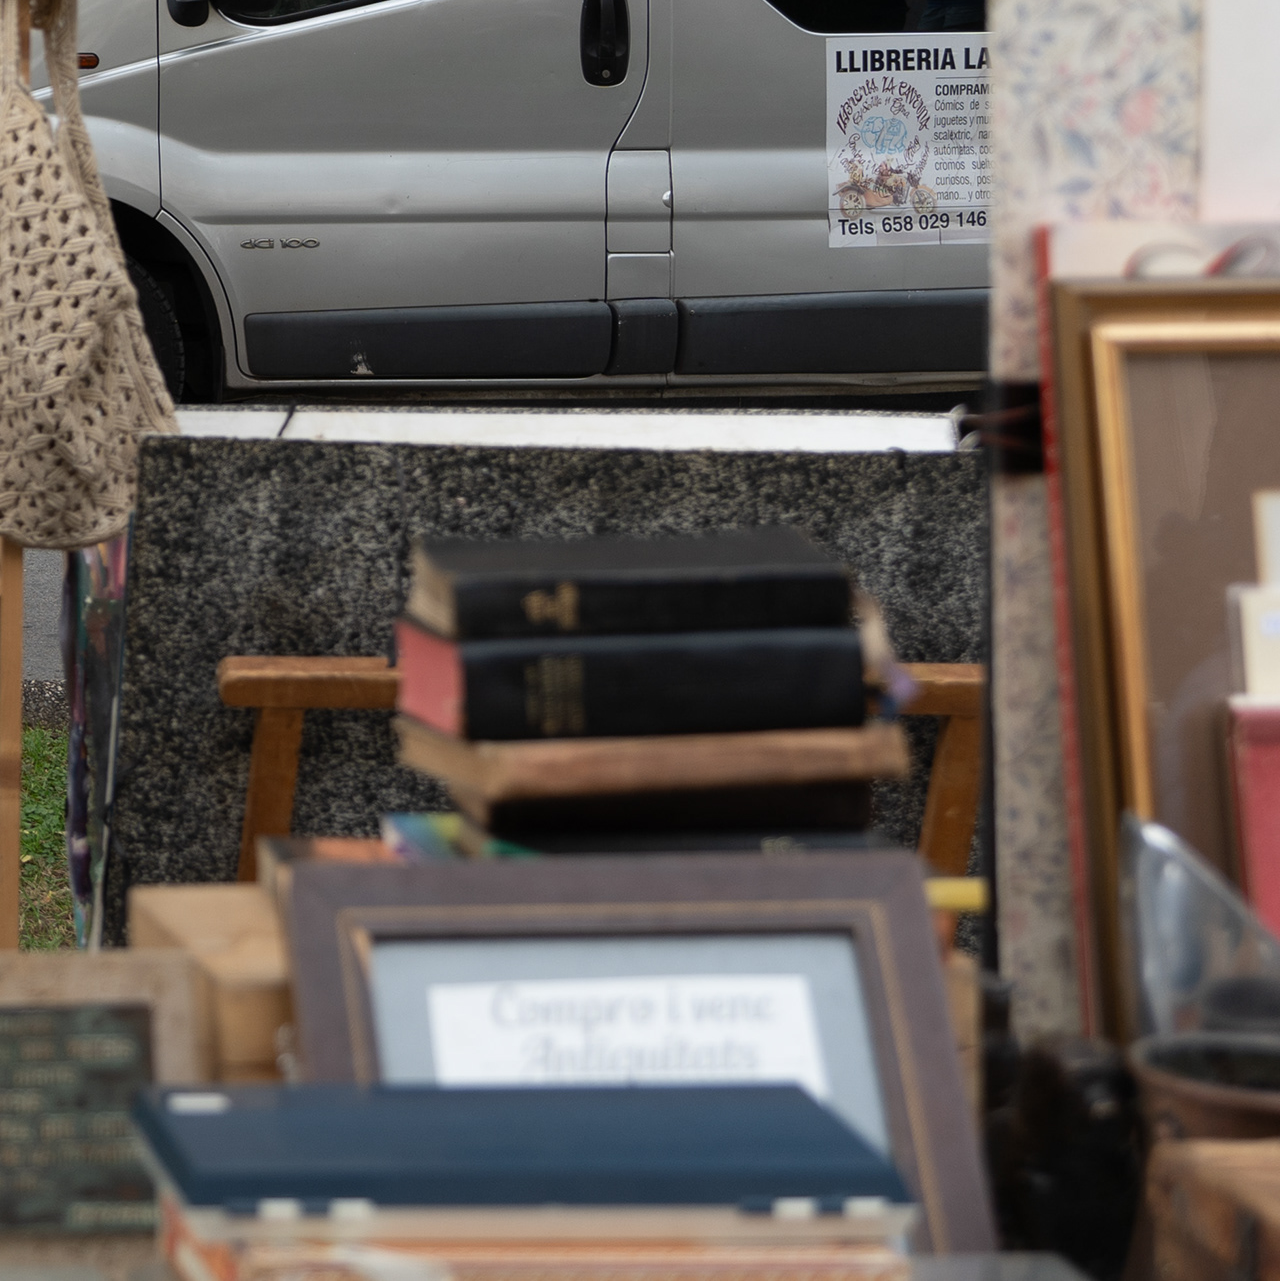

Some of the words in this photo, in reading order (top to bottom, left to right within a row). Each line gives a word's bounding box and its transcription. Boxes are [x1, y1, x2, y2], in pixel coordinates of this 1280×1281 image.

[835, 47, 957, 73] LLIBRERIA
[934, 99, 965, 111] Cómics
[970, 98, 980, 110] de
[933, 115, 968, 128] juguetes
[934, 161, 966, 171] cromos
[881, 215, 914, 234] 658
[918, 212, 950, 231] 029
[956, 210, 987, 228] 146
[280, 238, 320, 249] 100
